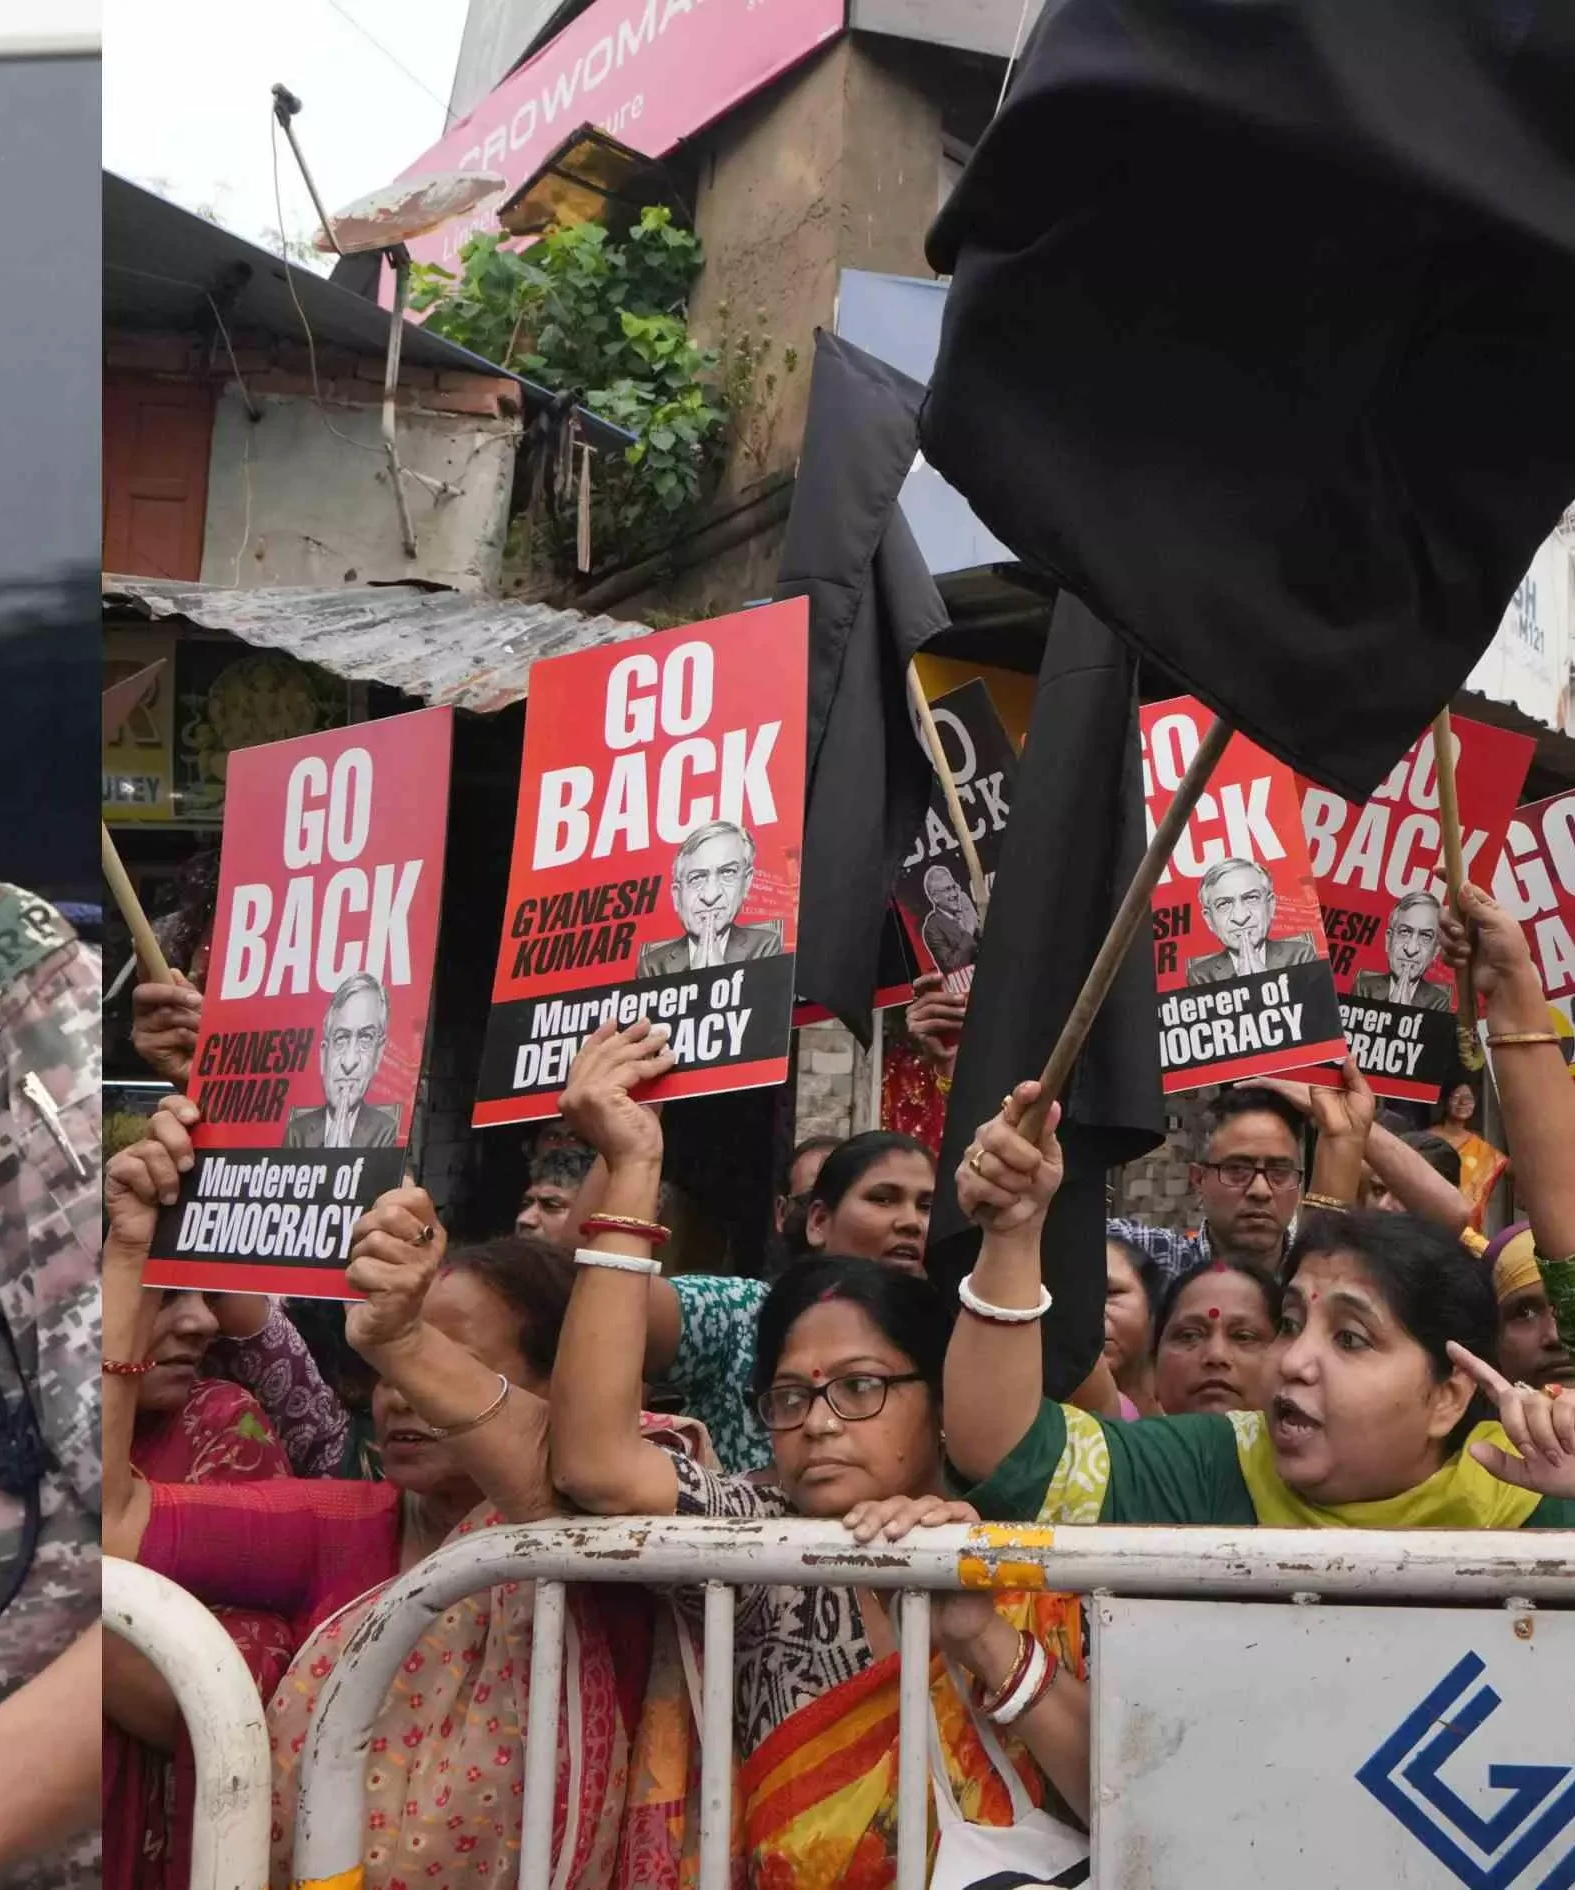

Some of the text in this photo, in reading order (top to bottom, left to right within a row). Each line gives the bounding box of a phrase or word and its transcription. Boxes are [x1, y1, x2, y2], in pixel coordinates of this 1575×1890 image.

[604, 640, 714, 750] GO
[921, 708, 977, 786] O
[283, 747, 373, 869] GO
[532, 720, 782, 871] BACK
[903, 771, 1010, 867] ACK
[220, 859, 424, 1000] BACK
[511, 874, 662, 938] GYANESH
[511, 922, 636, 980] KUMAR
[531, 969, 745, 1039] Murderer of
[1157, 973, 1289, 1027] derer of
[1399, 1013, 1424, 1040] of
[198, 1027, 314, 1077] GYANESH
[197, 1078, 290, 1124] KUMAR
[197, 1157, 365, 1200] Murderer of
[176, 1202, 363, 1260] DEMOCRACY
